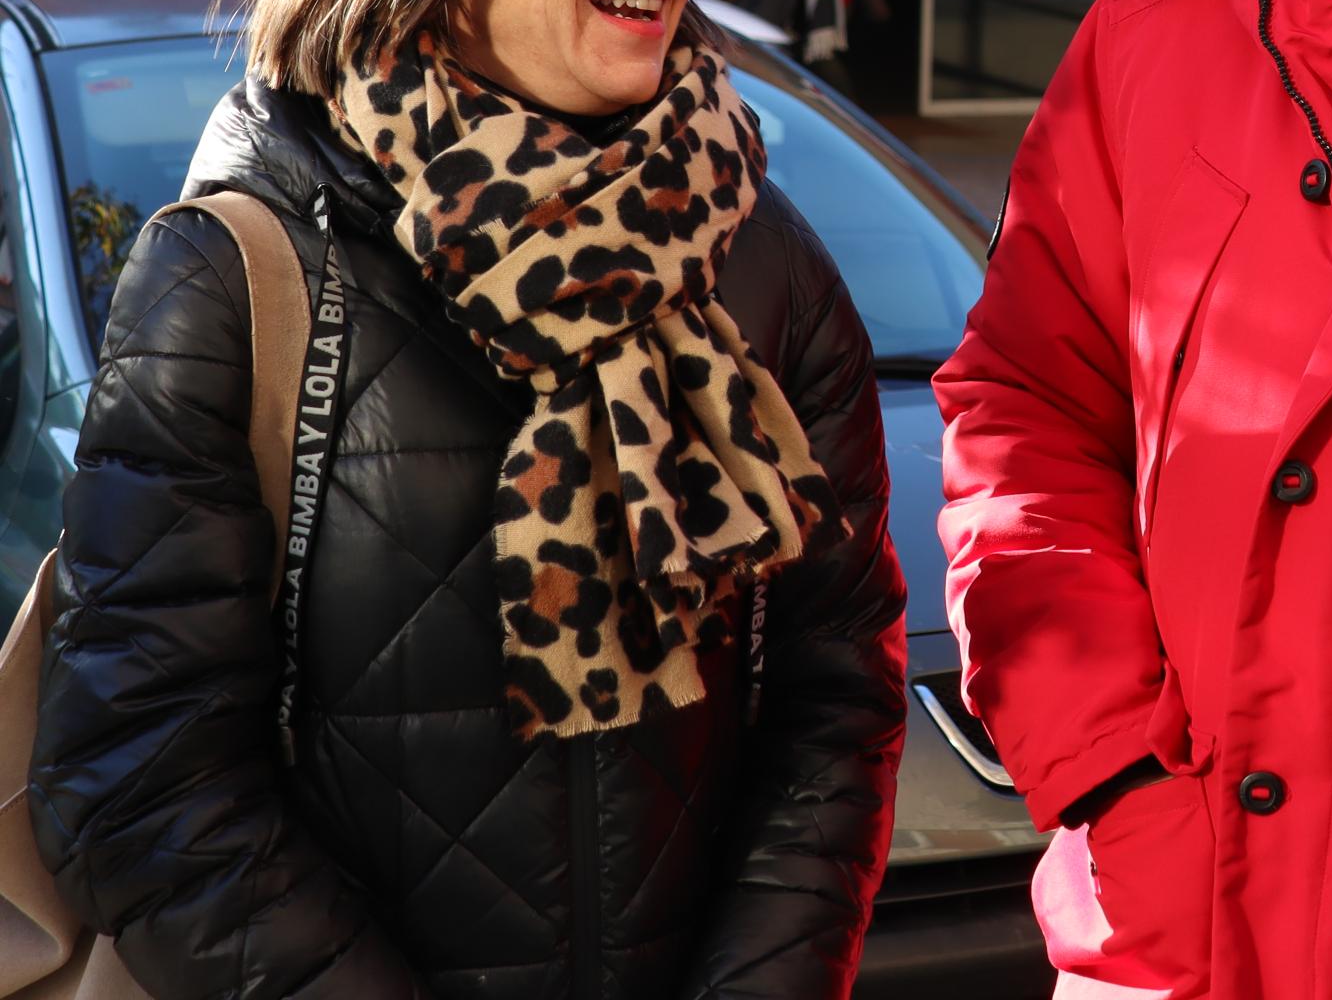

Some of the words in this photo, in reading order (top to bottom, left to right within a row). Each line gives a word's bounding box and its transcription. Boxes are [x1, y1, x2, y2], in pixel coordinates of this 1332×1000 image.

[301, 334, 344, 416] LOLA
[297, 420, 328, 445] Y
[289, 451, 325, 556] BIMBA
[284, 567, 304, 649] LOLA
